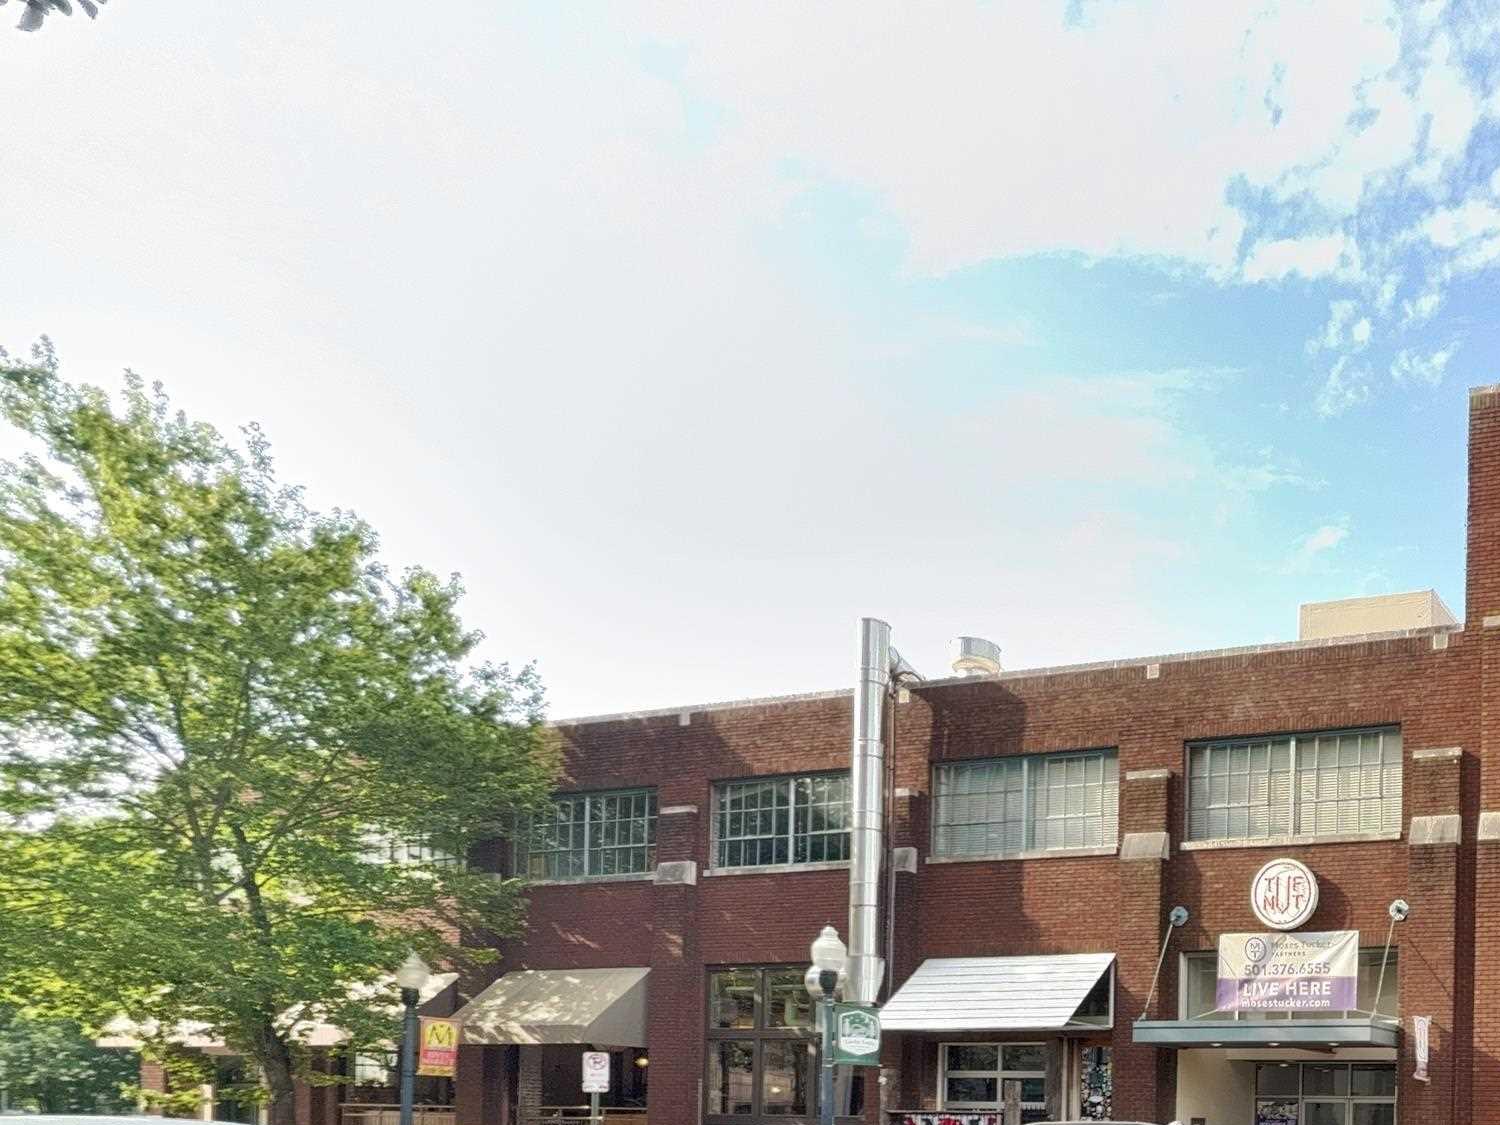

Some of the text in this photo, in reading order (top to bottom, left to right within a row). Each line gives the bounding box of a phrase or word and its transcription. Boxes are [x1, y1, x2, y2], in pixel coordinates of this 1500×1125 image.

[1244, 962, 1331, 977] 501.376.6555
[1243, 981, 1332, 997] LIVE HERE
[1240, 998, 1331, 1009] mosestucker.com
